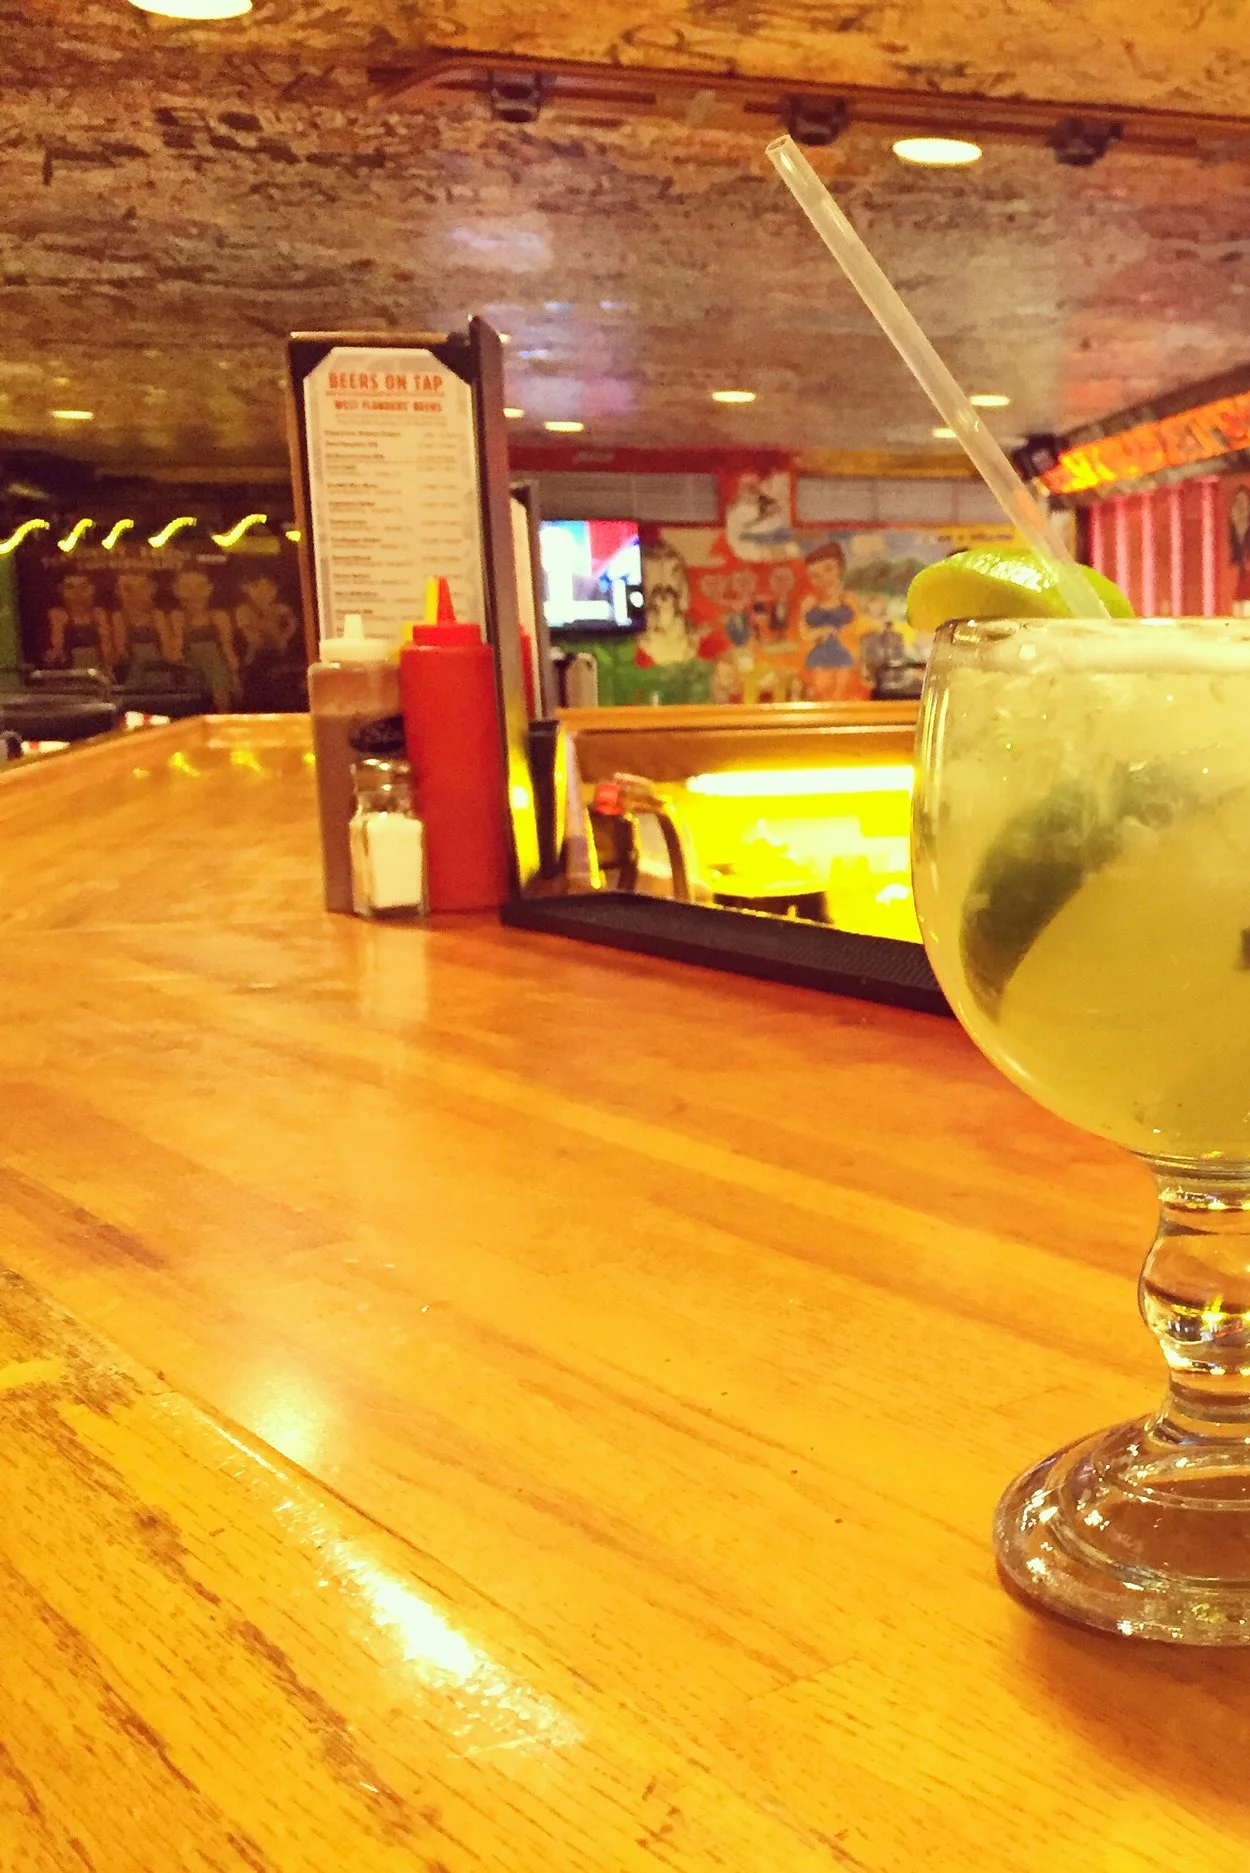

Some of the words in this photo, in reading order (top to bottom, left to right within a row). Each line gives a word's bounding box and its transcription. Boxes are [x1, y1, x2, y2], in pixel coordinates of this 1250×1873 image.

[328, 372, 378, 390] BEERS
[385, 374, 407, 391] ON
[413, 374, 443, 391] TAP
